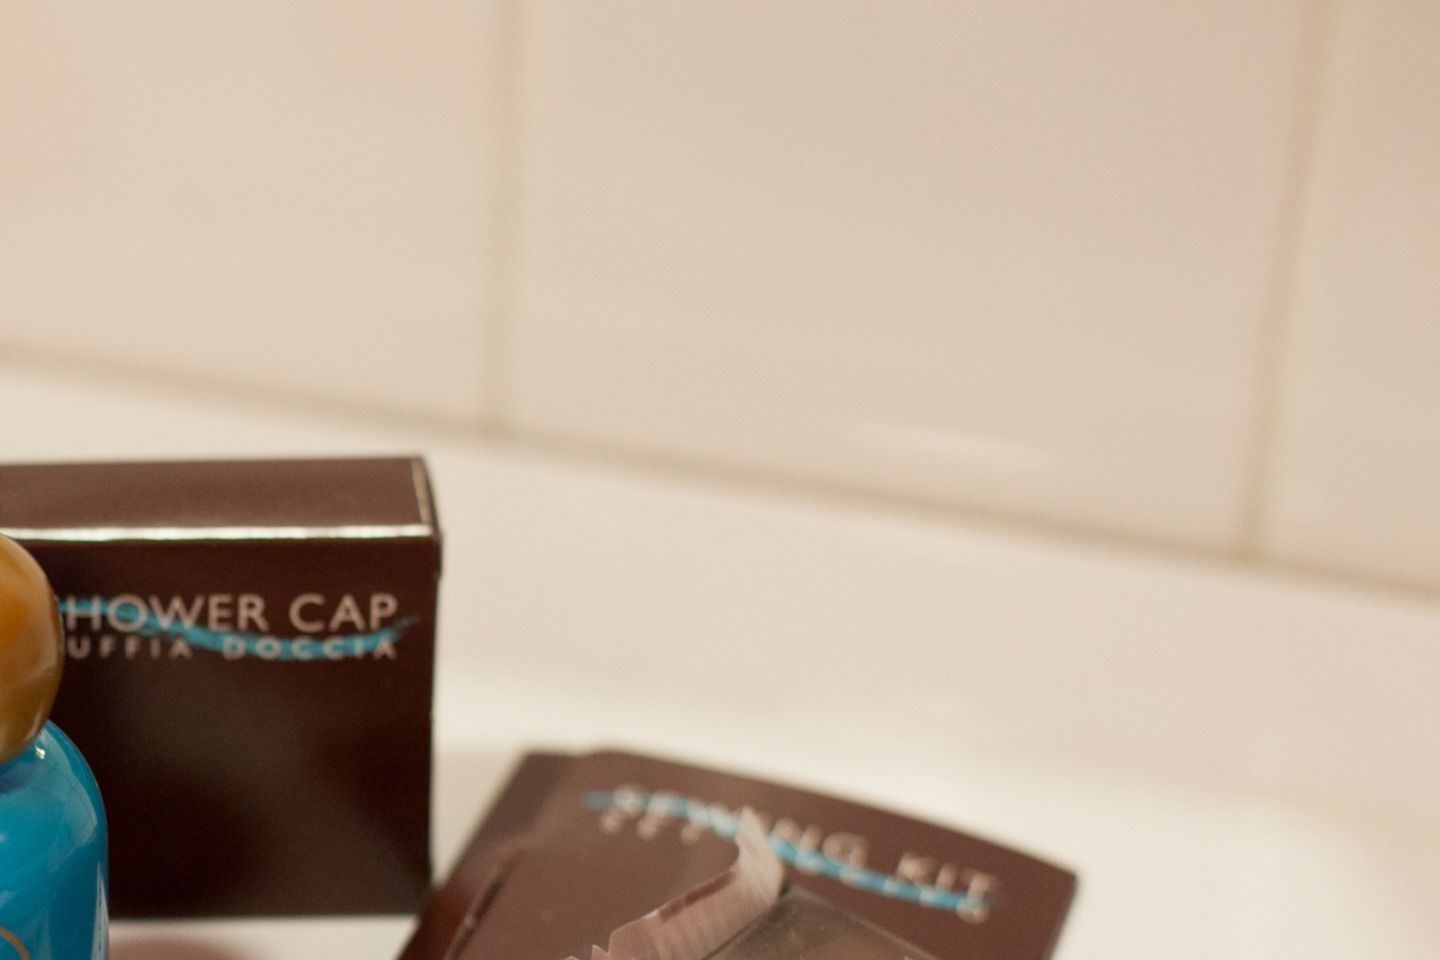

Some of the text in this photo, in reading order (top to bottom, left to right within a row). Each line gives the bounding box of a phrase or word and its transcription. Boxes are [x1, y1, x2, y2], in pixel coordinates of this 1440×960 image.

[66, 593, 399, 633] HOWER CAP
[66, 635, 194, 660] UFFIA
